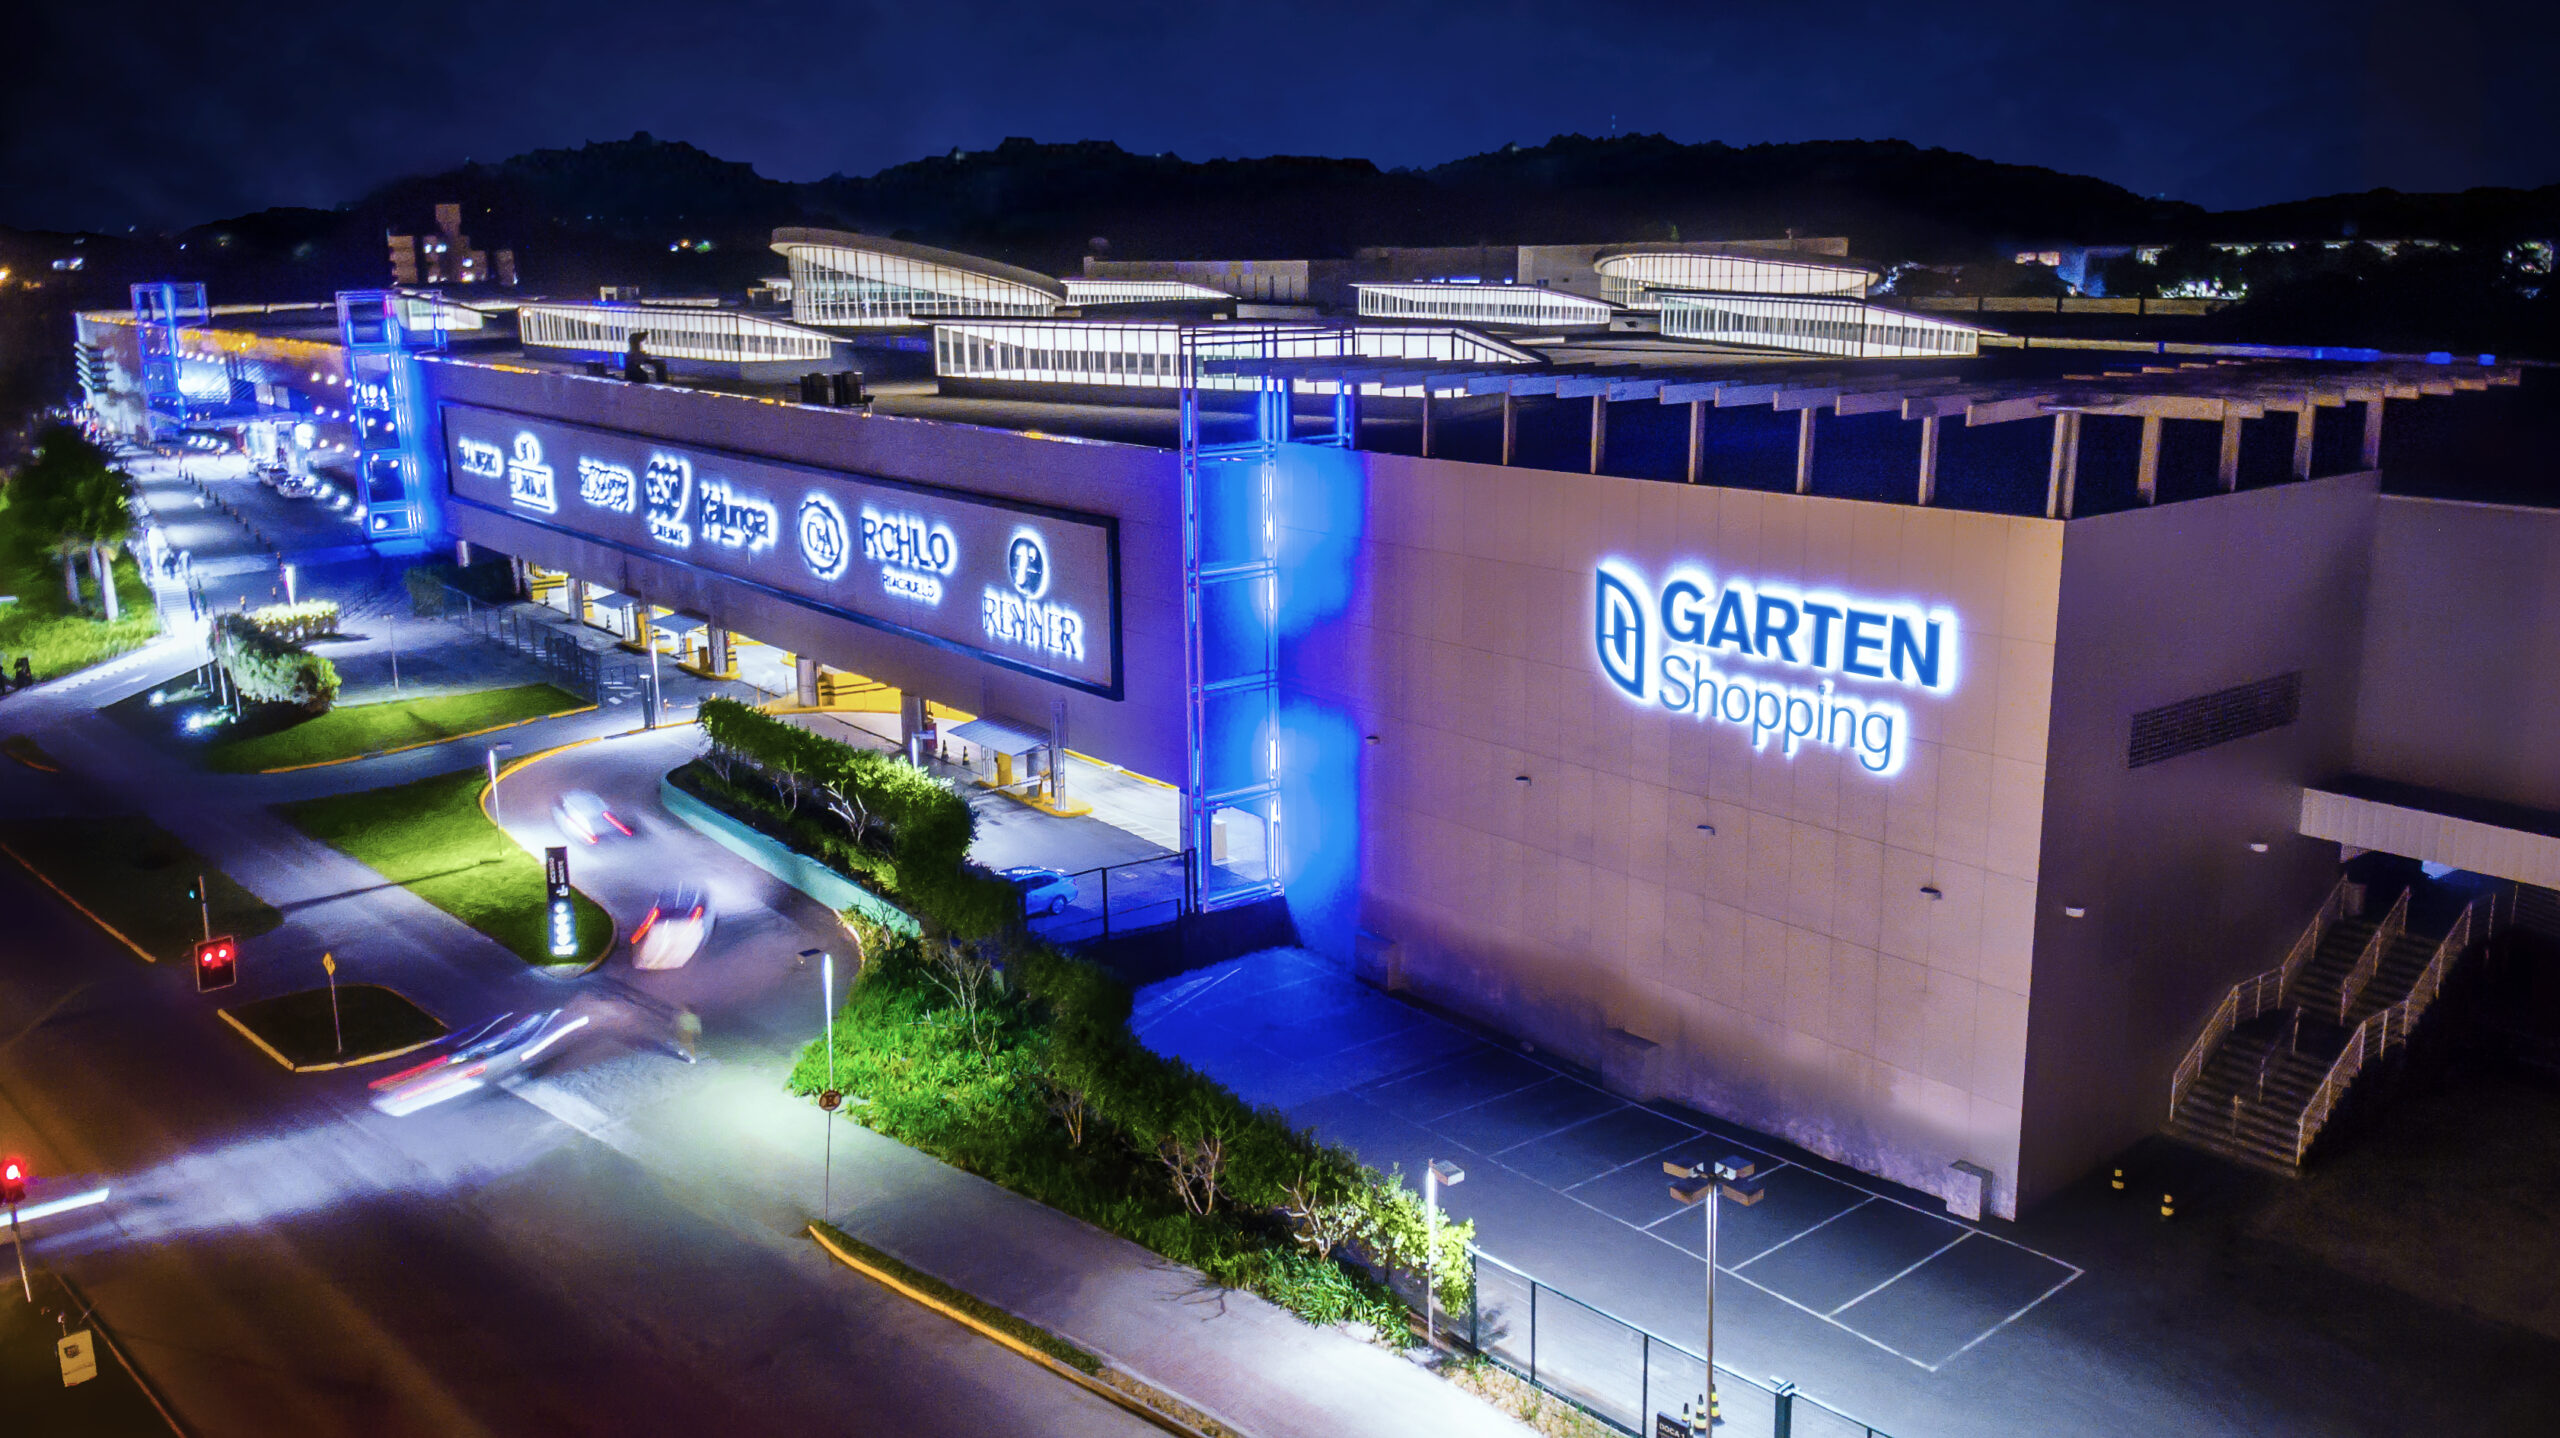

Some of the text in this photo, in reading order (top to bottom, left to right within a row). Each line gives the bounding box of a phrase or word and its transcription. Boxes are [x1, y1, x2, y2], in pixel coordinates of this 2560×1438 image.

[860, 515, 950, 570] RCHLO
[982, 595, 1078, 656] RENNER
[1660, 579, 1941, 688] GARTEN
[1658, 654, 1894, 772] Shopping
[1658, 1422, 1680, 1438] DOCA
